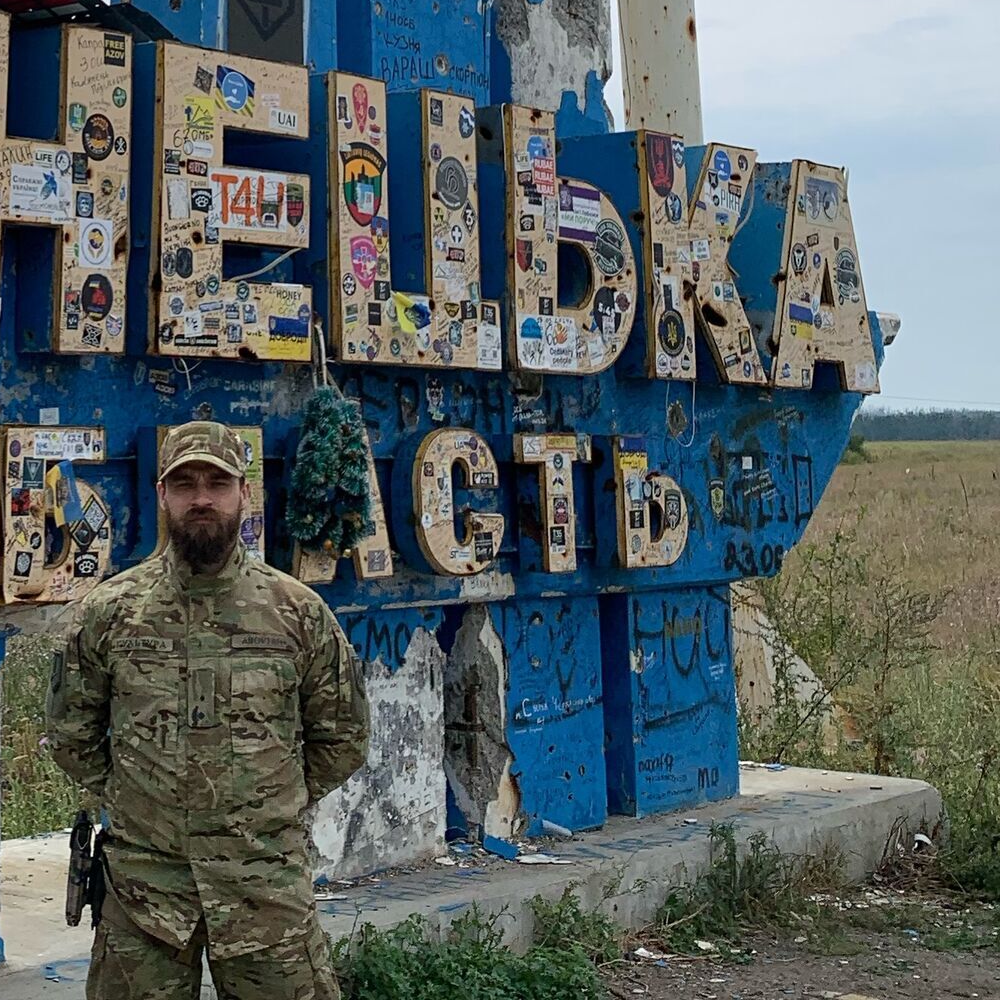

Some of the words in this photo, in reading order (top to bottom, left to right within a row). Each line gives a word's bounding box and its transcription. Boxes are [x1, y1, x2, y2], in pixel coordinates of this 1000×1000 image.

[105, 40, 125, 50] FREE
[105, 50, 125, 59] AZOV
[35, 153, 53, 163] LIFE
[211, 173, 284, 227] T4U
